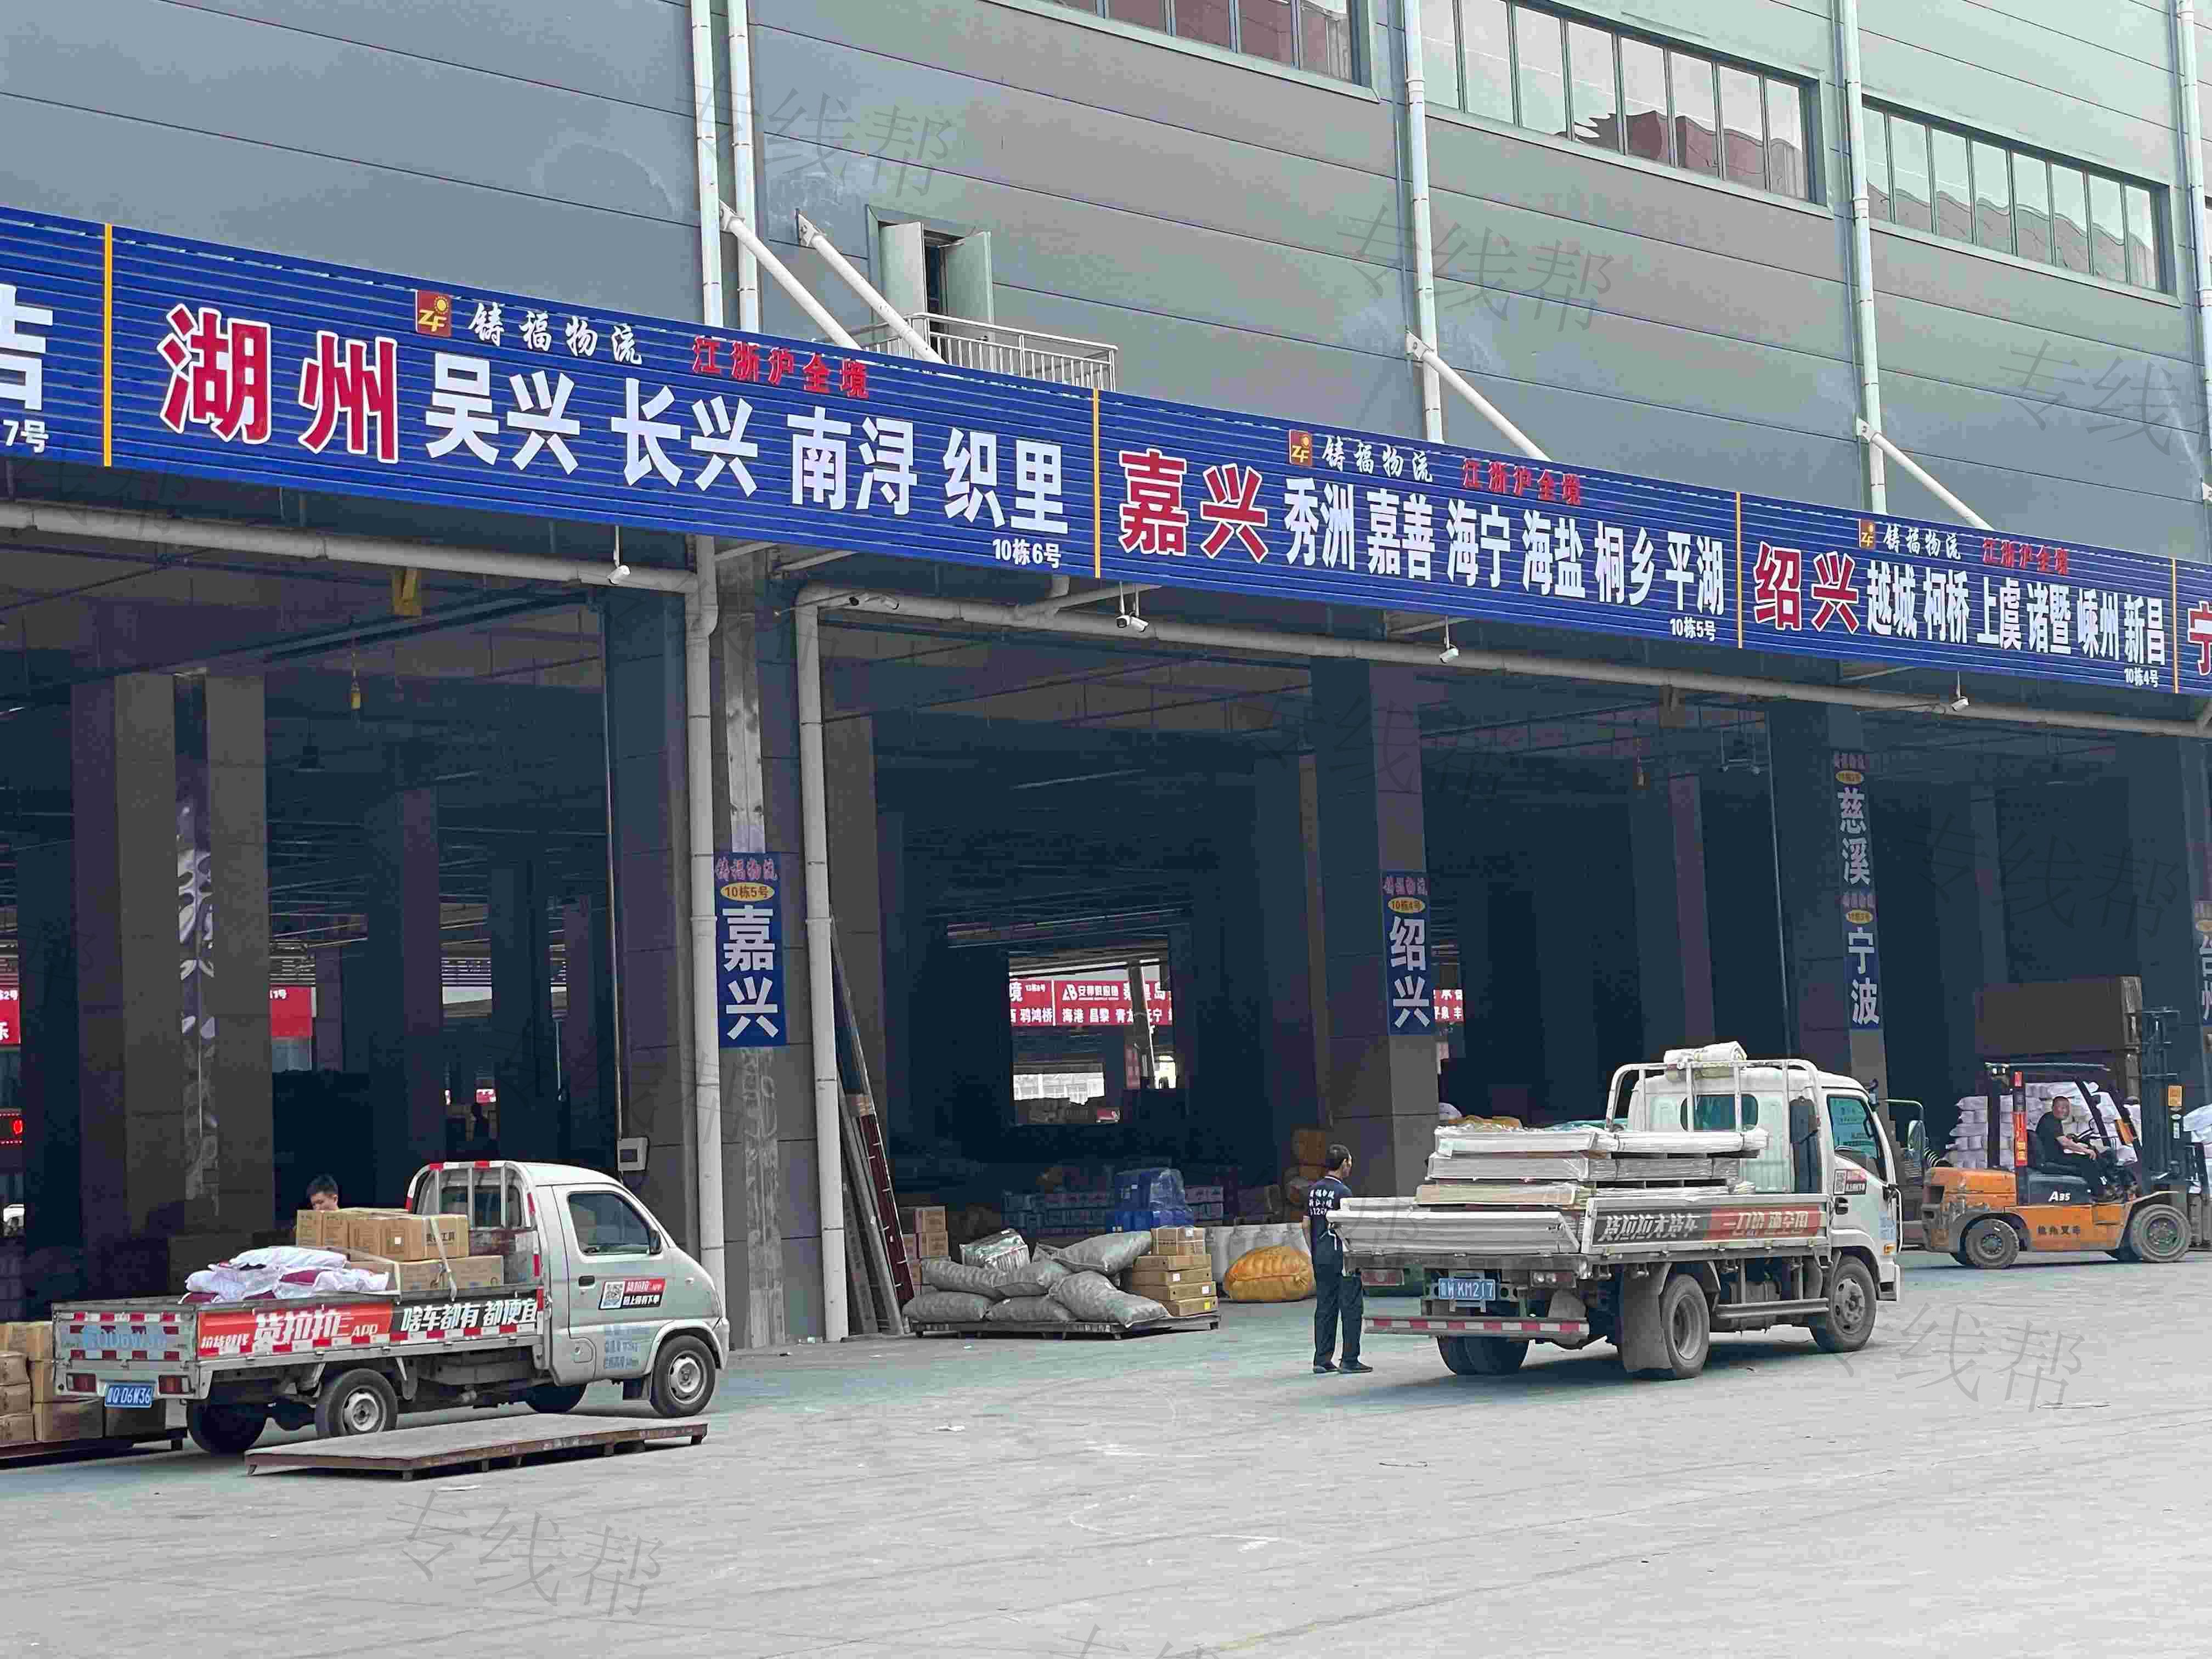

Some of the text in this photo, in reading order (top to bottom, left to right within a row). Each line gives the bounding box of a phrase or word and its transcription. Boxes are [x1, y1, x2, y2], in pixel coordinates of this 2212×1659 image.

[468, 302, 642, 364] 铸福物流
[692, 335, 869, 399] 江浙沪全境
[157, 303, 1068, 534] 湖州 吴兴 长兴 南浔 织里
[1322, 435, 1434, 483] 铸福物流
[1462, 456, 1581, 505] 江浙沪全境
[992, 538, 1062, 569] 10栋6号
[1119, 448, 1725, 616] 嘉兴 秀洲 嘉善 海宁 海盐 桐乡 平湖
[1670, 616, 1717, 642] 10栋5号
[1753, 541, 2166, 666] 绍兴 越城 柯桥 上虞 诸暨 嵊州 新昌
[1838, 786, 1870, 885] 慈溪
[724, 885, 769, 899] 10栋5号
[722, 904, 780, 1041] 嘉兴
[1389, 916, 1431, 1028] 绍兴
[1847, 927, 1880, 1025] 宁波
[1062, 1007, 1084, 1023] 海港
[254, 1310, 343, 1345] 货拉拉
[352, 1324, 378, 1338] APP
[400, 1298, 537, 1332] 啥车都有 都便宜
